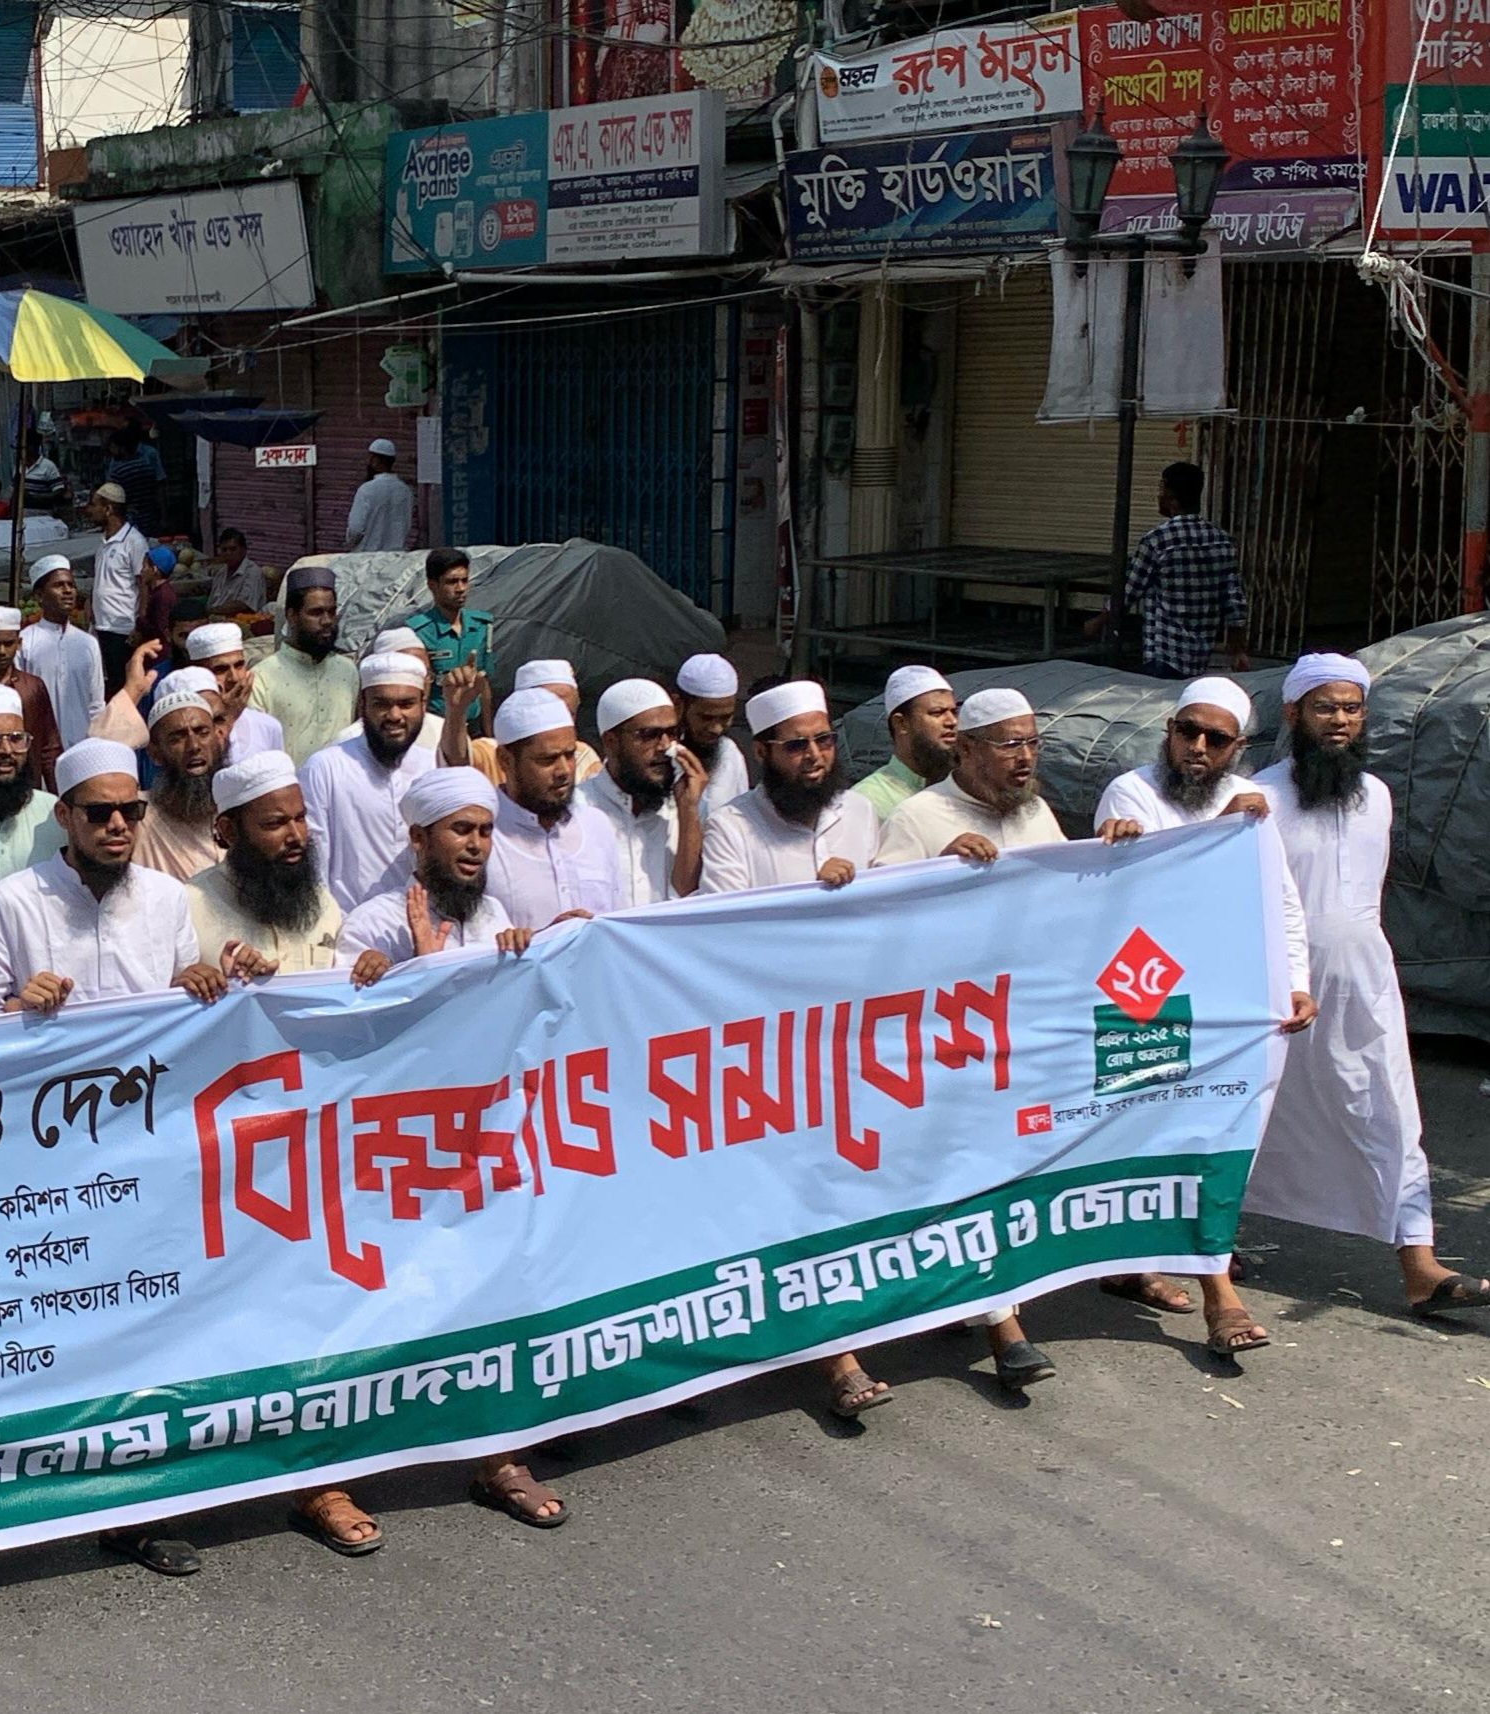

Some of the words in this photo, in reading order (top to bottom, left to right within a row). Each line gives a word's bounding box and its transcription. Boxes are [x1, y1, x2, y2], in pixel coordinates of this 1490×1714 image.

[1453, 0, 1490, 23] PA
[891, 46, 967, 96] রূপ
[978, 28, 1072, 112] মহল
[1104, 59, 1167, 106] পাঞ্জাবী
[1172, 68, 1204, 101] শপ
[403, 141, 471, 183] Avanee
[417, 176, 458, 209] pants
[793, 154, 869, 228] মুক্তি
[1395, 173, 1490, 214] WAL
[109, 222, 165, 260] ওয়াহেদ
[204, 216, 231, 249] এন্ড
[451, 471, 469, 547] ERGER
[1112, 957, 1169, 1004] ২৫
[1106, 1051, 1134, 1068] রোজ
[1133, 1028, 1169, 1047] ২০২৫
[33, 1054, 169, 1149] দেশ
[1053, 1101, 1102, 1125] রাজশাহী
[1172, 1084, 1204, 1100] জিরো
[1208, 1080, 1249, 1097] পয়েন্ট
[193, 1048, 617, 1291] বিক্ষোভ
[648, 973, 1011, 1171] সমাবেশ
[75, 1175, 140, 1211] বাতিল
[5, 1231, 90, 1279] পুনর্বহাল
[31, 1282, 120, 1315] গণহত্যার
[129, 1269, 182, 1303] বিচার
[187, 1342, 518, 1451] বাংলাদেশ
[528, 1257, 765, 1400] রাজশাহী
[772, 1209, 1000, 1312] মহানগর
[1007, 1198, 1039, 1249] ও
[1049, 1174, 1203, 1236] জেলা
